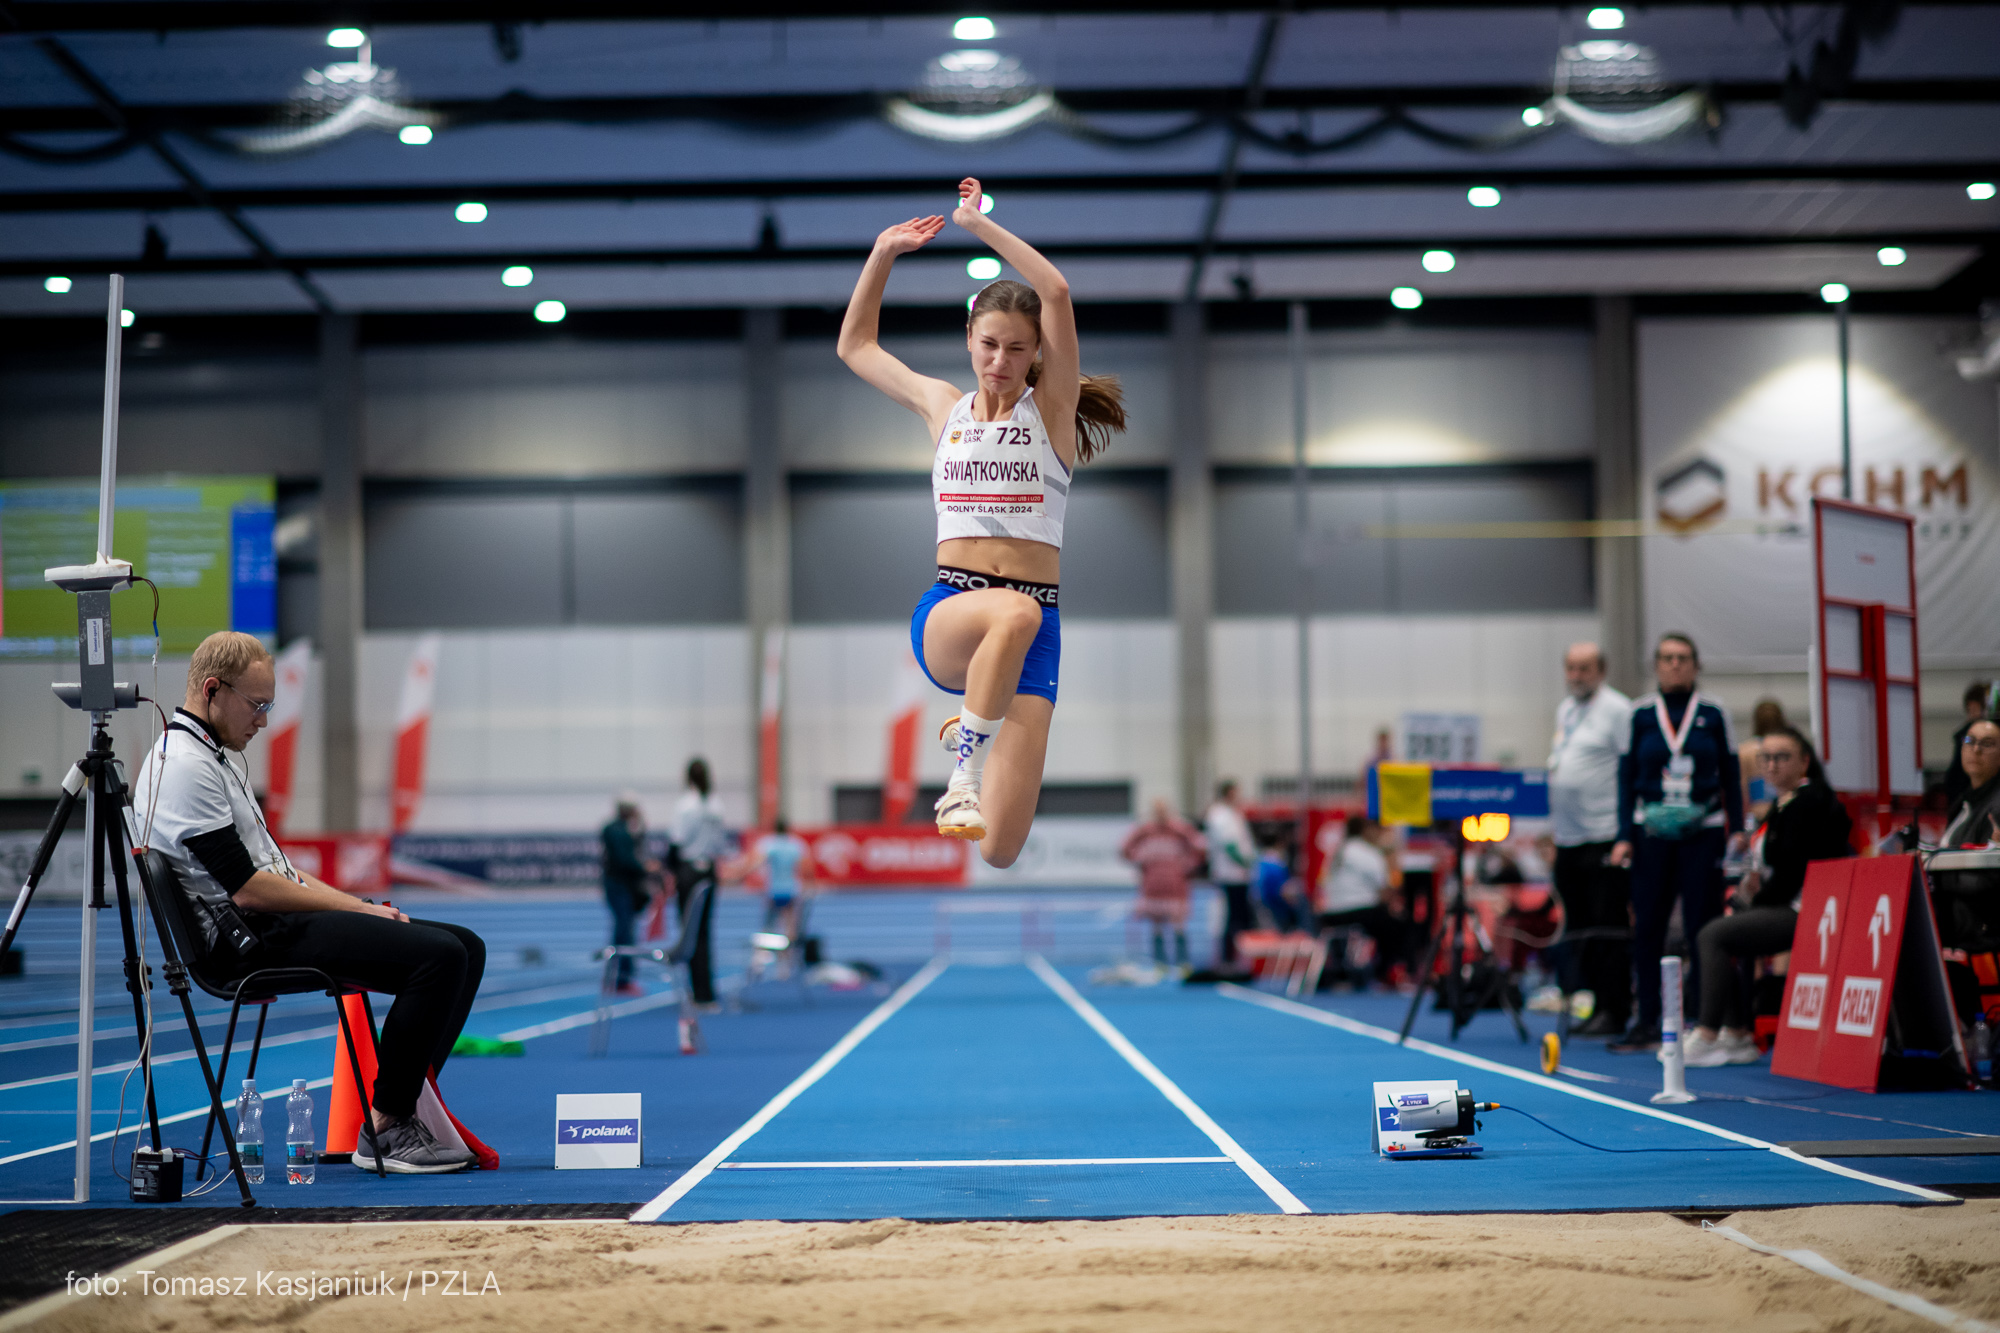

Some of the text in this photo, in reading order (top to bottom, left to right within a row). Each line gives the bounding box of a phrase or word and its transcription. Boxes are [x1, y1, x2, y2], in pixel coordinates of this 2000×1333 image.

[996, 427, 1032, 445] 725
[943, 457, 1039, 485] ŚWIĄTKOWSKA
[947, 503, 1033, 515] DOLNY ŚLĄSK 2024
[937, 569, 989, 590] PRO
[960, 725, 991, 747] ST
[1841, 986, 1879, 1027] ORLEN
[581, 1125, 633, 1139] polanik
